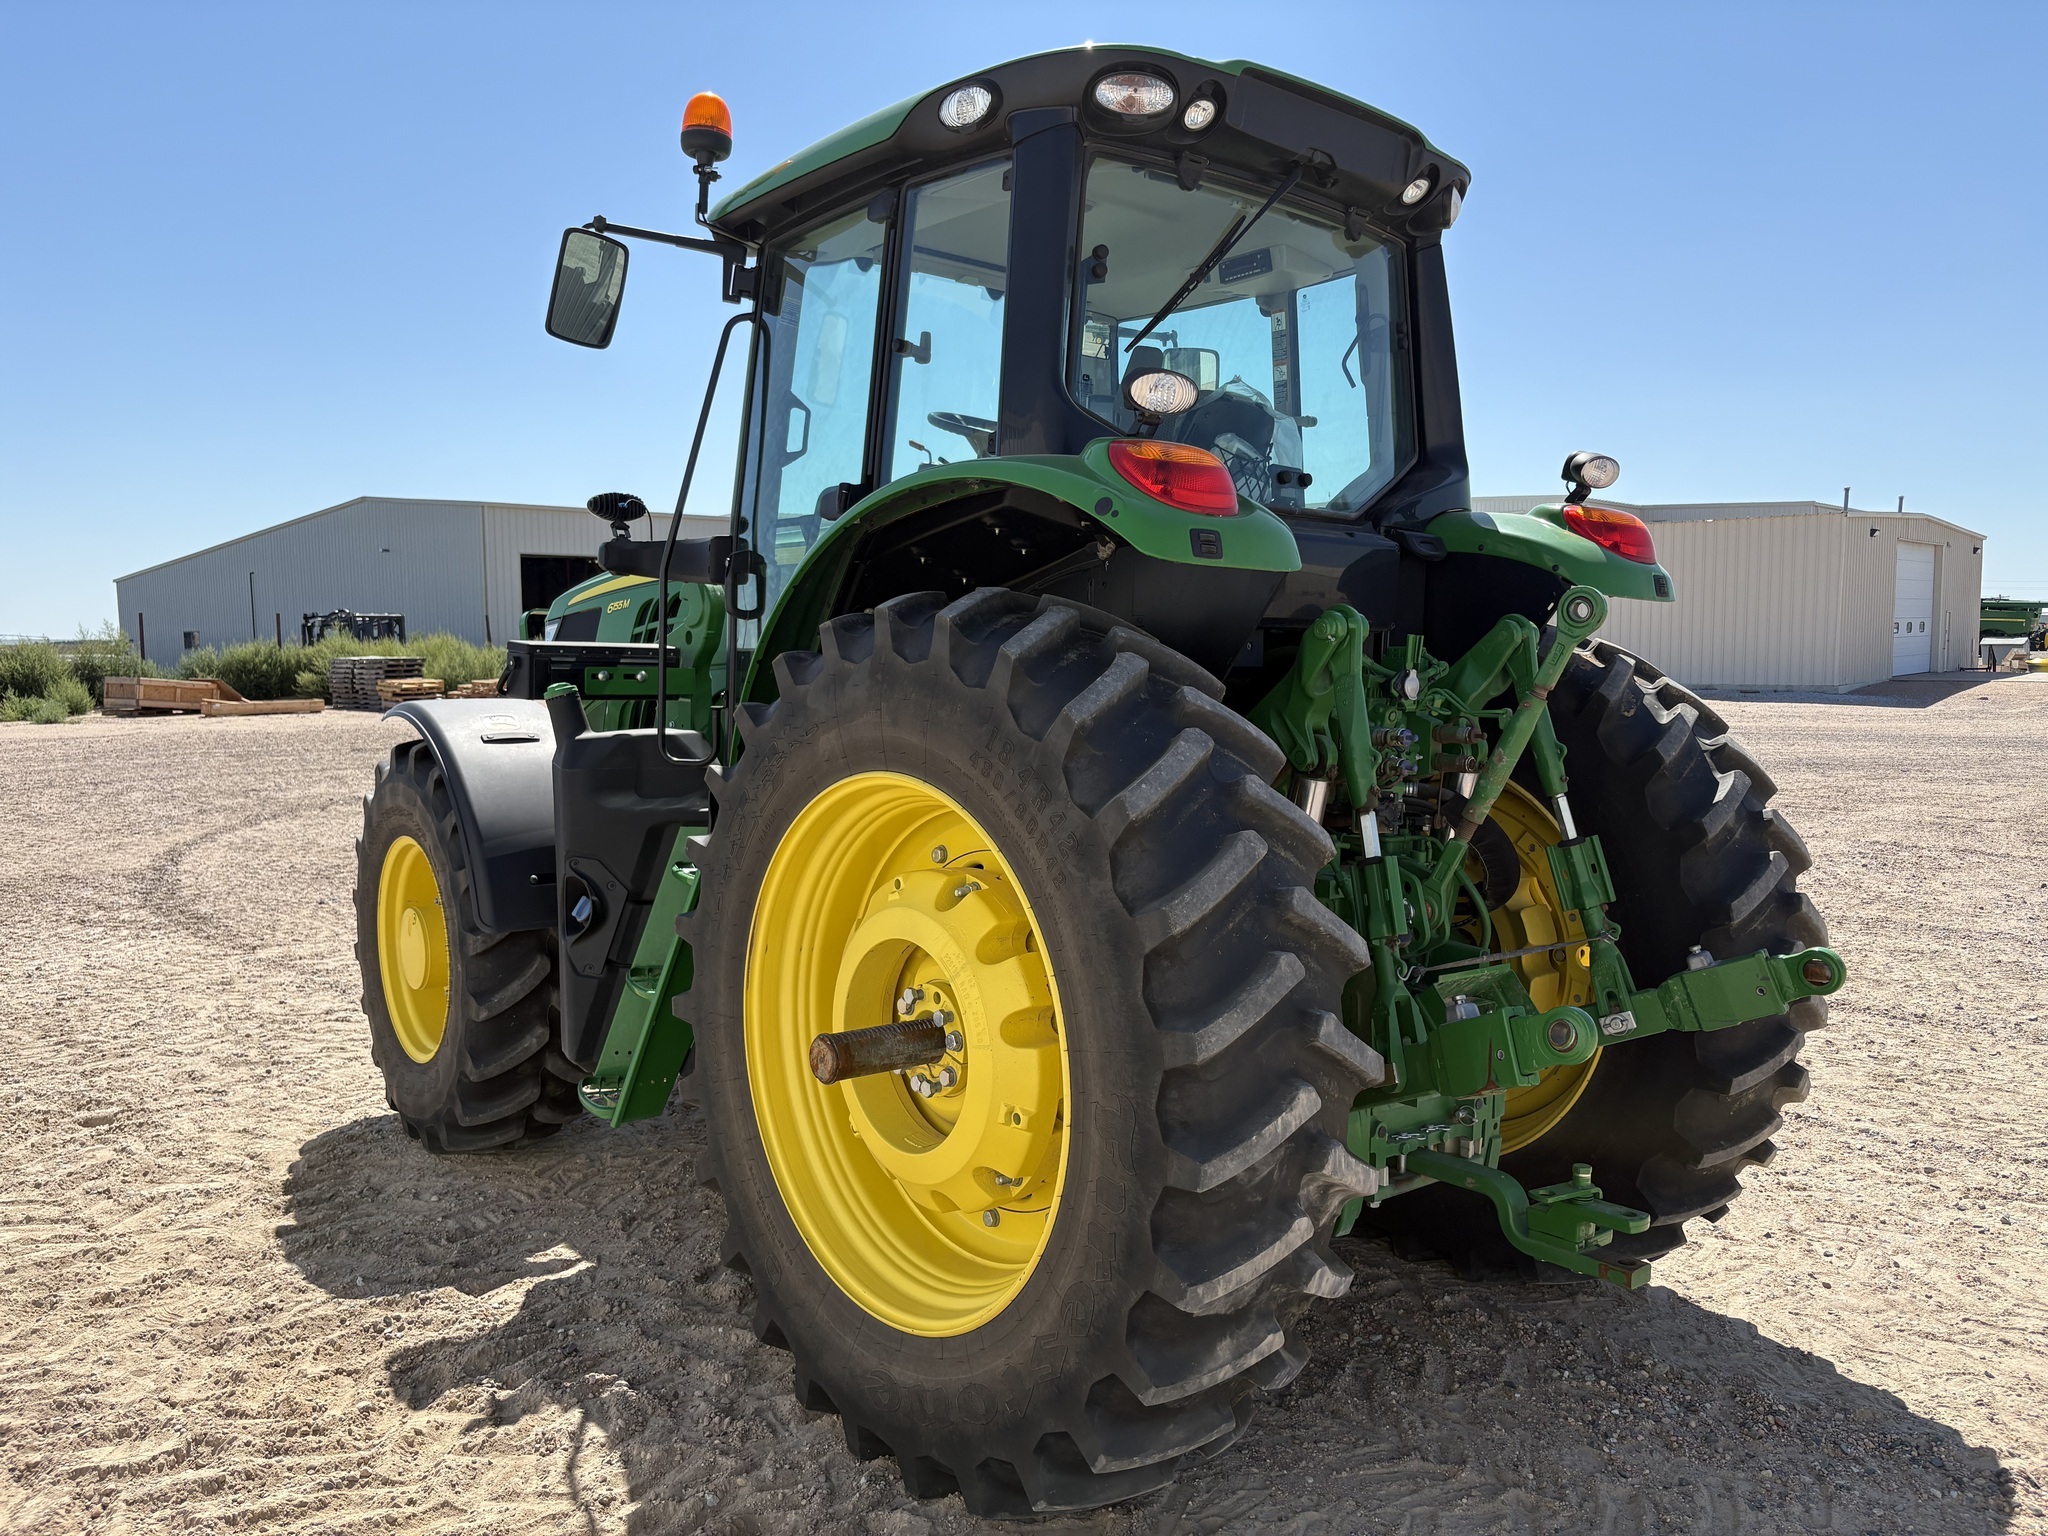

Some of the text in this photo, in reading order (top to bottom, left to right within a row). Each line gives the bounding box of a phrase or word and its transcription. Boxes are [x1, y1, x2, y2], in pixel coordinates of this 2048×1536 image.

[607, 598, 631, 614] 6155M
[969, 751, 1067, 890] 480/80R42
[984, 726, 1081, 863] 18.4R42
[865, 1092, 1138, 1428] Firestone
